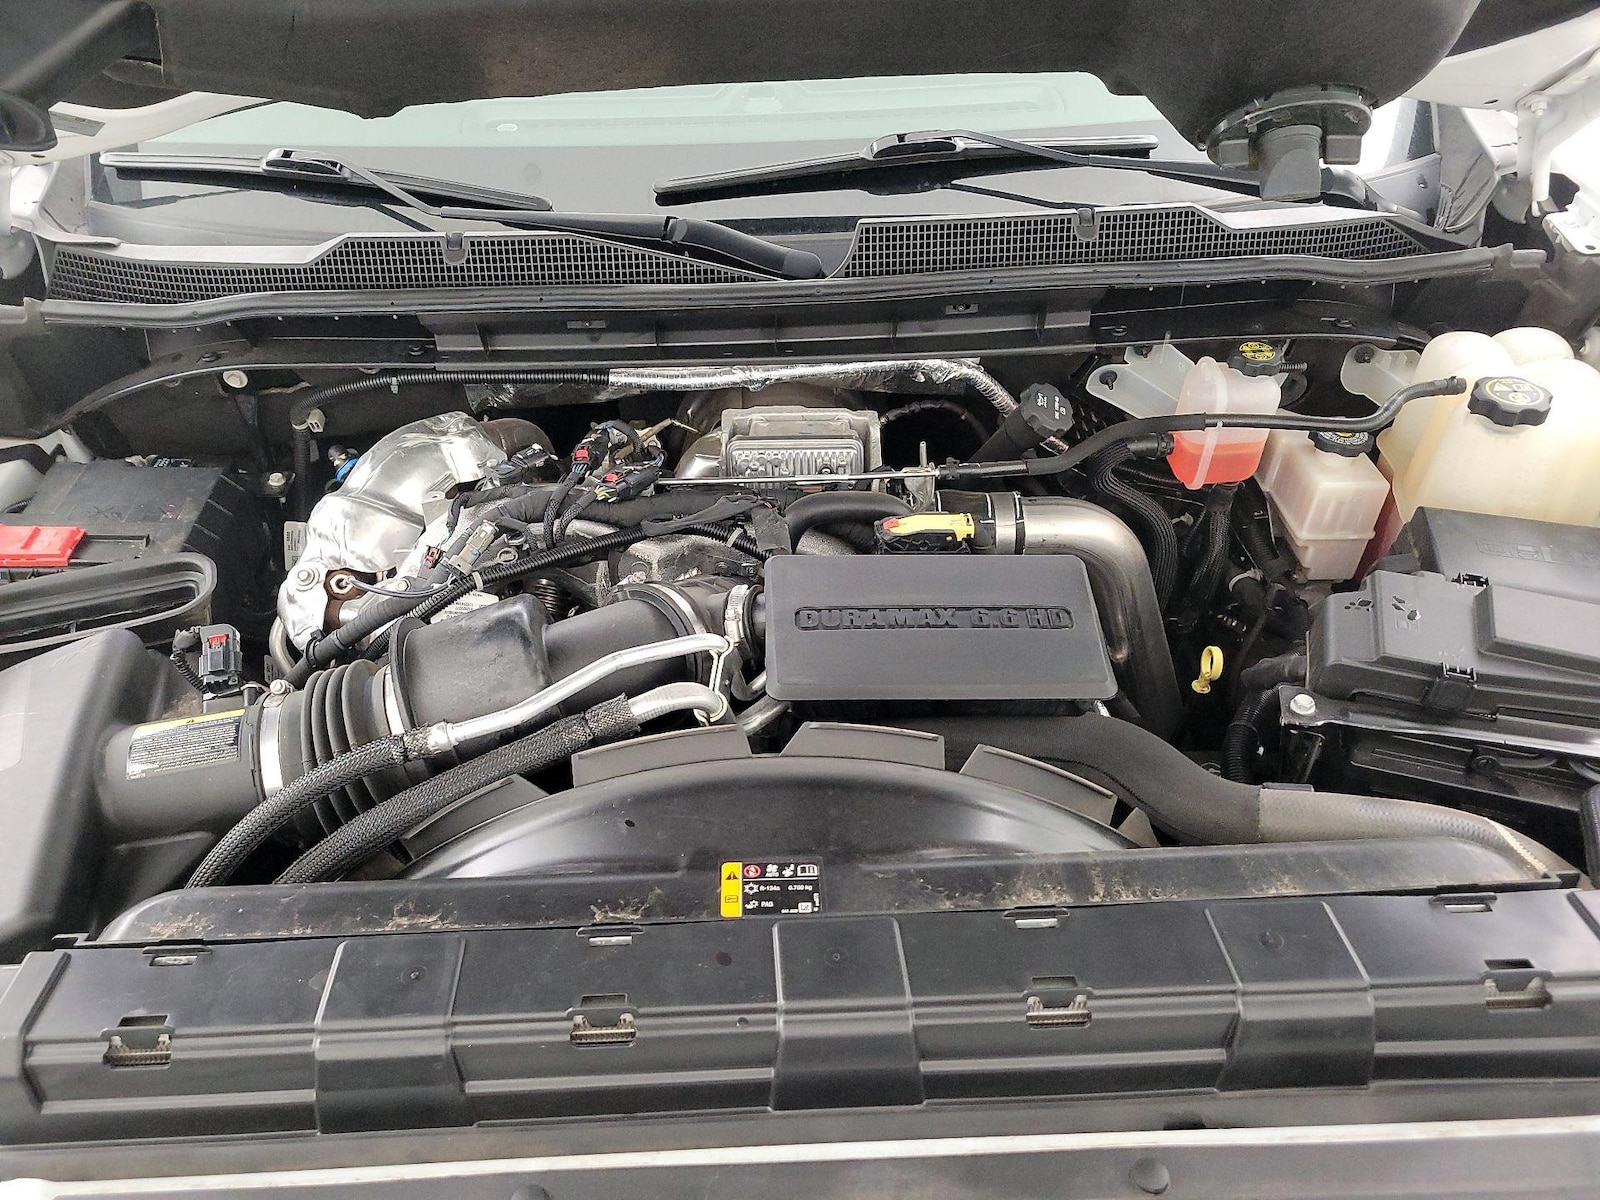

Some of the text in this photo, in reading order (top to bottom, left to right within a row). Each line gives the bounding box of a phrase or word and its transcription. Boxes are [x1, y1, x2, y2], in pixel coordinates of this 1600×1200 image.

[800, 608, 1071, 629] DURAMAX 6.6 HD
